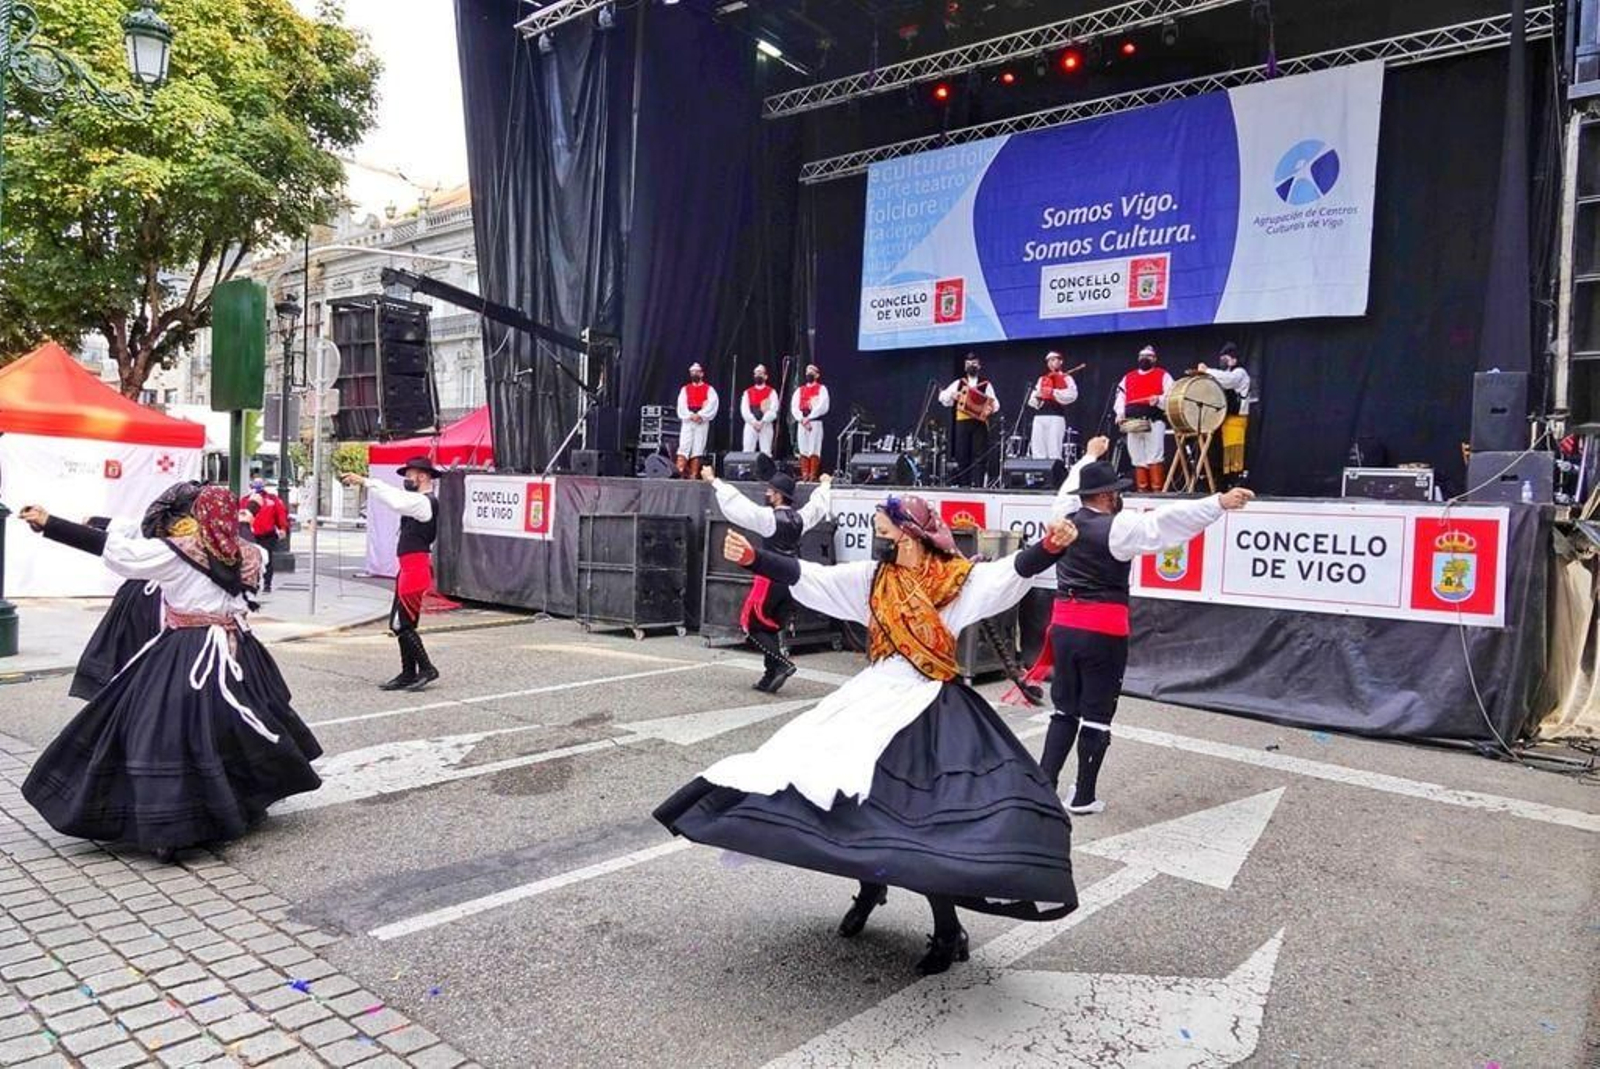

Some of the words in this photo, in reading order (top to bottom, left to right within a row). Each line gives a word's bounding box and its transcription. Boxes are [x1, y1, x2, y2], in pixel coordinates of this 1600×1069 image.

[1042, 202, 1113, 229] Somos
[1121, 192, 1179, 220] Vigo.
[1319, 206, 1359, 217] Centros
[1322, 218, 1343, 230] Vigo
[1022, 237, 1093, 263] Somos
[1100, 223, 1197, 252] Cultura.
[1050, 272, 1121, 291] CONCELLO
[870, 292, 928, 309] CONCELLO
[1057, 291, 1074, 303] DE
[1078, 287, 1112, 302] VIGO
[877, 310, 891, 321] DE
[895, 306, 921, 319] VIGO
[472, 491, 519, 504] CONCELLO
[477, 506, 488, 518] DE
[491, 507, 512, 520] VIGO
[845, 532, 867, 549] DE
[1236, 529, 1387, 557] CONCELLO
[1252, 557, 1286, 579] DE
[1297, 560, 1366, 584] VIGO
